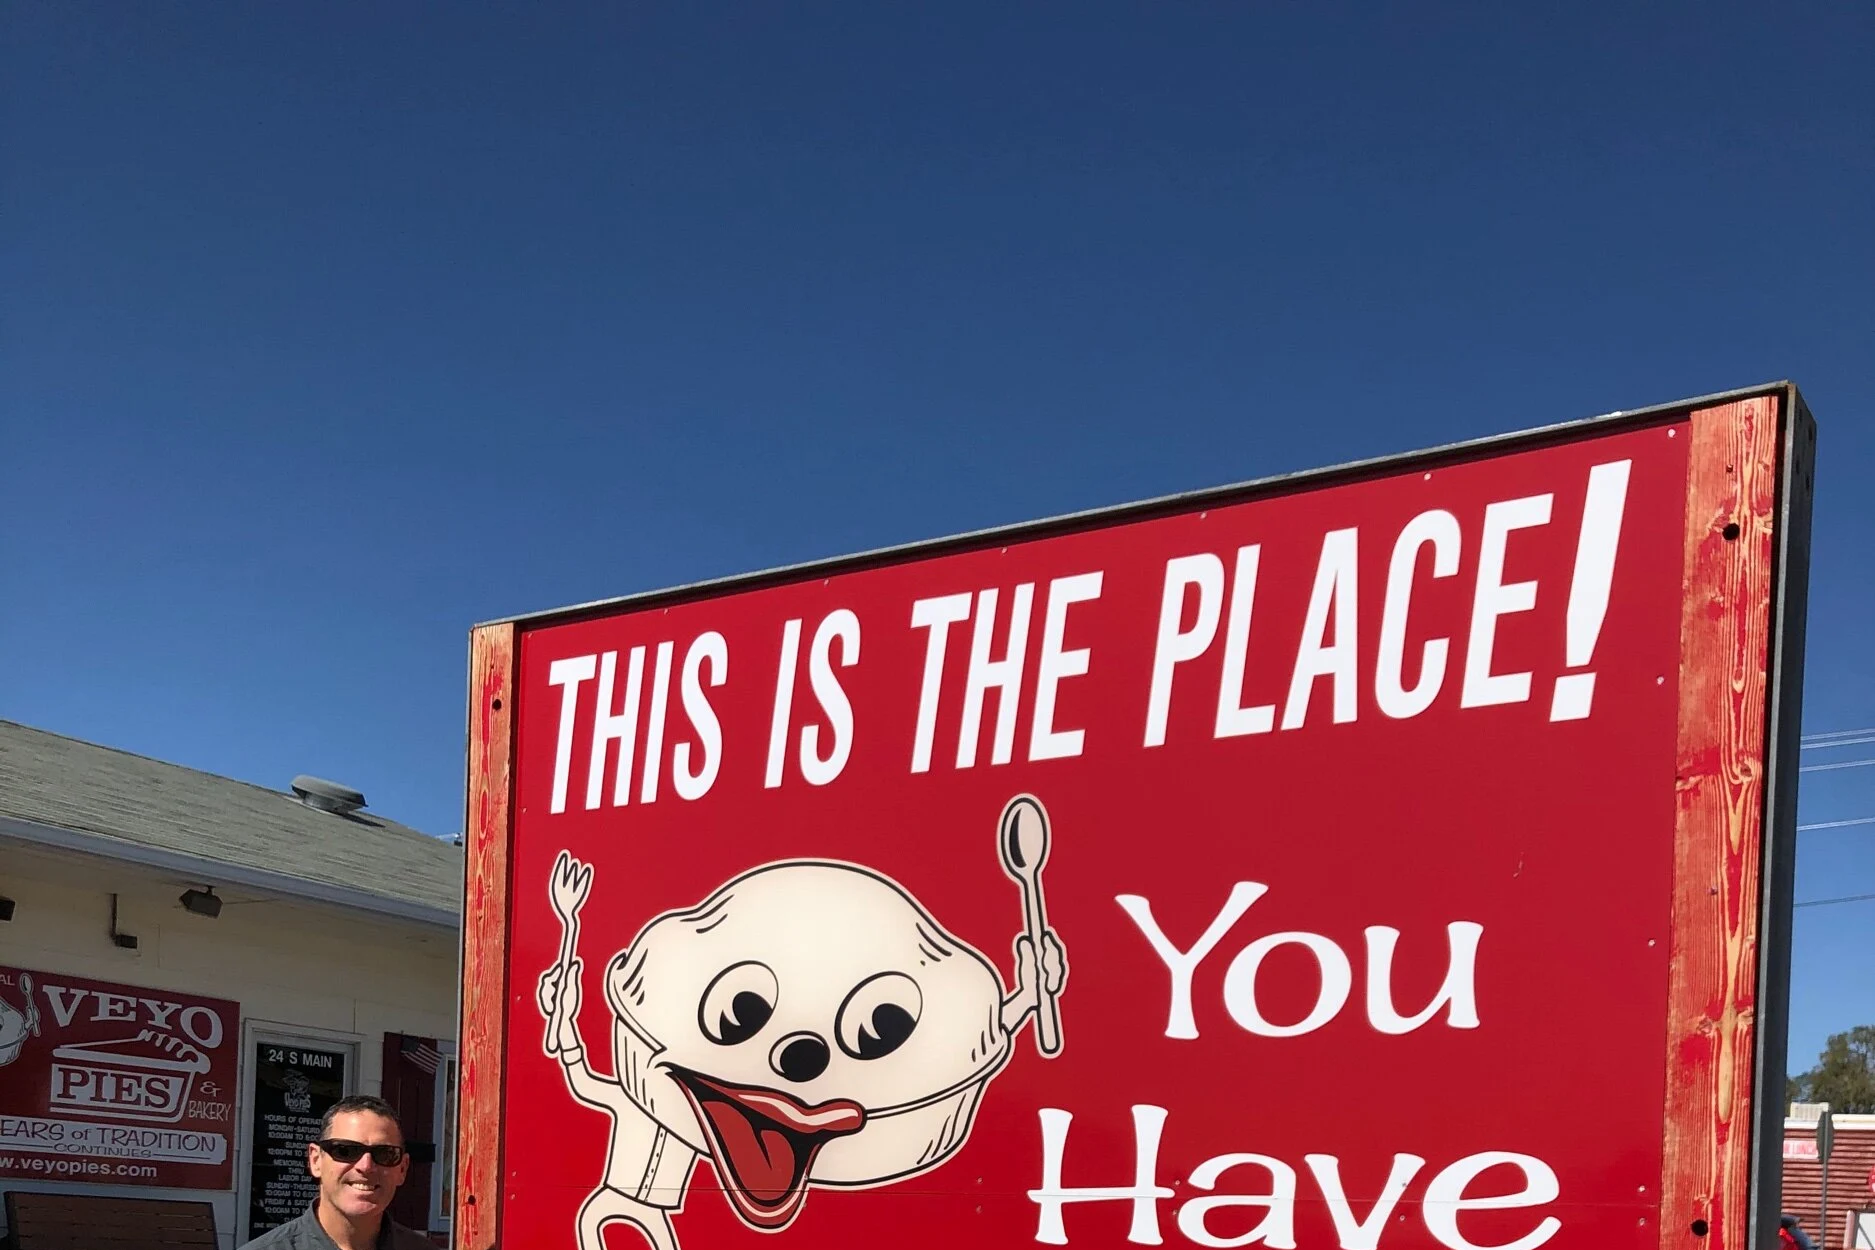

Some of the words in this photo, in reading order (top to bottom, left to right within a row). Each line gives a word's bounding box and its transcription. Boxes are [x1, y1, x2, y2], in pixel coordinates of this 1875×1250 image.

[549, 632, 727, 813] THIS
[765, 610, 860, 788] IS
[911, 572, 1103, 773] THE
[1144, 459, 1631, 747] PLACE!
[1116, 882, 1483, 1039] You
[42, 984, 223, 1049] VEYO
[269, 1049, 284, 1063] 24
[289, 1051, 298, 1064] S
[302, 1053, 332, 1068] MAIN
[57, 1067, 170, 1109] PIES
[200, 1081, 222, 1097] &
[188, 1100, 232, 1122] BAKERY
[264, 1114, 286, 1122] HOURS
[71, 1128, 92, 1140] of
[96, 1127, 216, 1152] TRADITION
[54, 1143, 152, 1158] CONTINUES
[294, 1149, 303, 1157] TO
[273, 1159, 305, 1167] MEMORIAL
[264, 1198, 286, 1206] FRIDAY
[292, 1190, 301, 1198] TO
